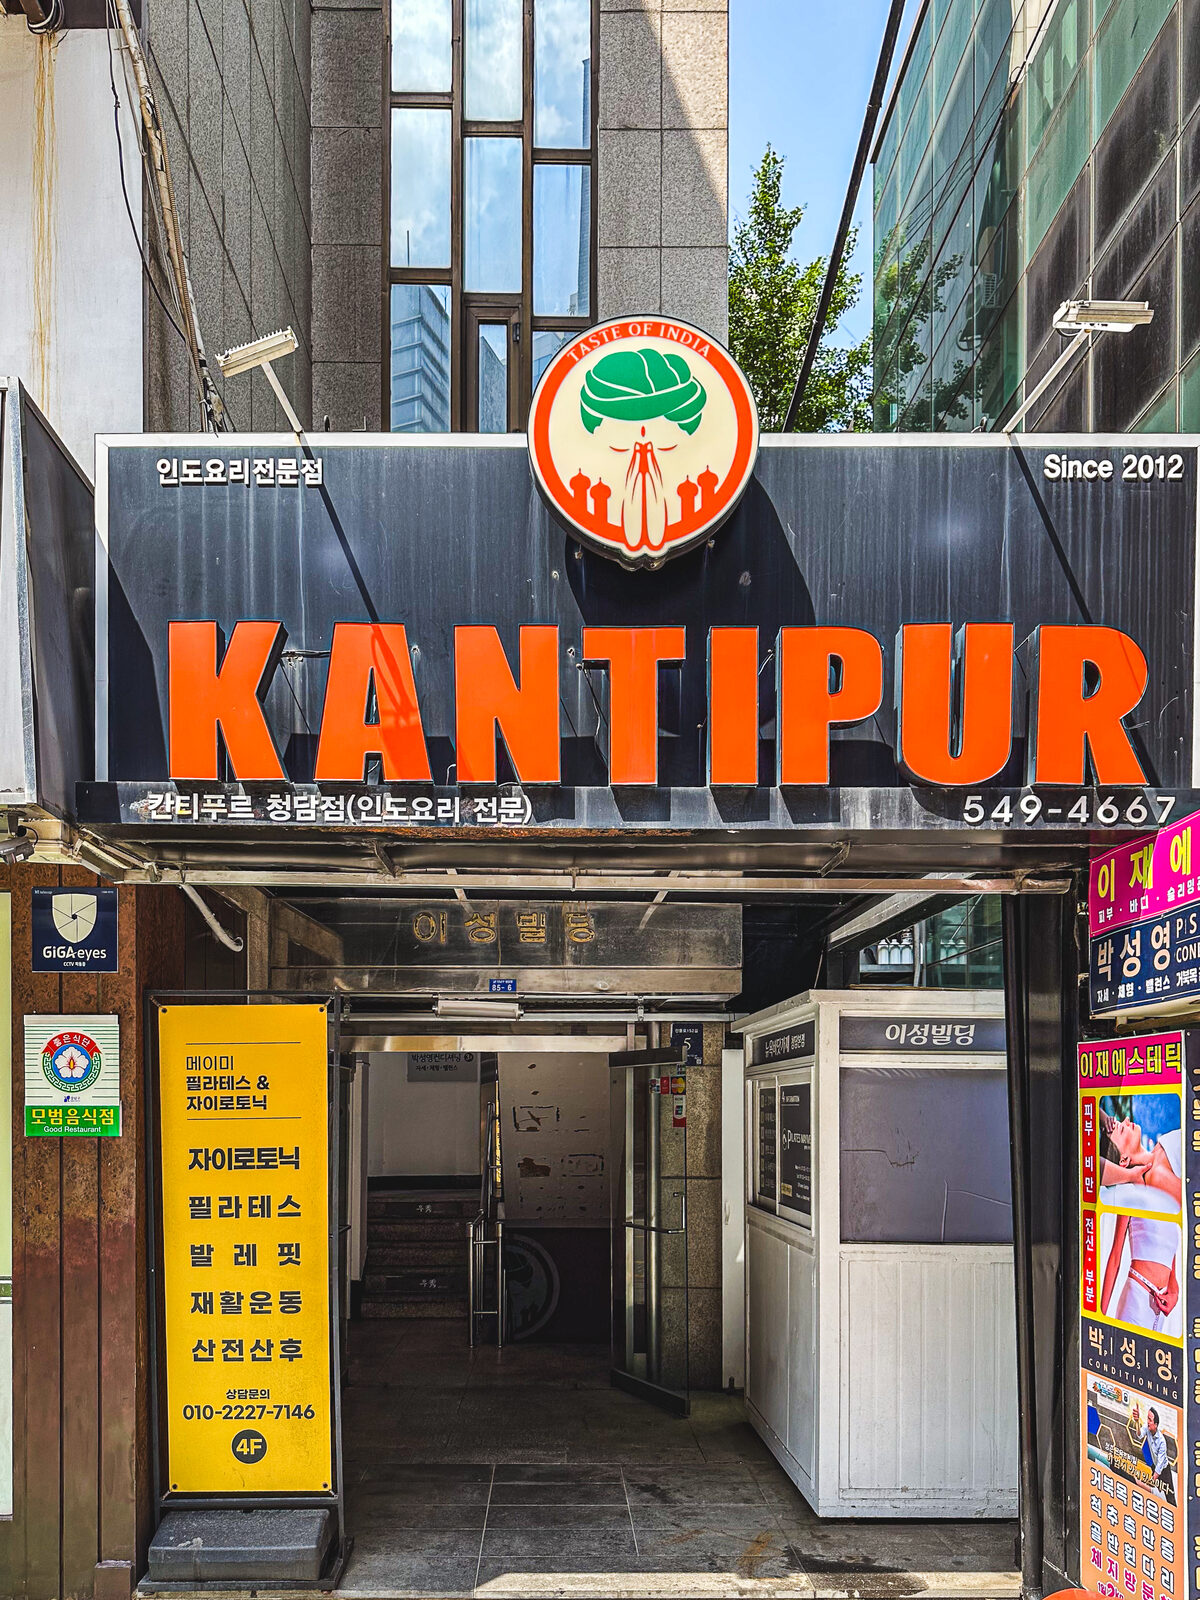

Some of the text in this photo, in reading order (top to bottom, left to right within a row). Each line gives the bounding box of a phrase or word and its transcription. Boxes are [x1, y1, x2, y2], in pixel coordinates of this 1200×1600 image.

[567, 323, 711, 362] TASTE OF INDIA
[156, 457, 324, 487] 인도요리전문점
[1043, 454, 1183, 480] Since 2012
[168, 619, 1149, 788] KANTIPUR
[147, 793, 254, 821] 칸티푸르
[473, 793, 533, 823] 전문)
[963, 794, 1177, 824] 549-4667
[1129, 897, 1149, 914] 바디
[1098, 920, 1171, 982] 박성영
[885, 1023, 976, 1046] 이성빌딩
[186, 1055, 234, 1072] 메이미
[1080, 1043, 1181, 1079] 이재에스테틱
[186, 1075, 270, 1091] 필라테스 &
[186, 1095, 268, 1111] 자이로토닉
[31, 1108, 114, 1126] 모범음식점
[188, 1146, 300, 1171] 자이로토닉
[1084, 1103, 1094, 1193] 피부 비만
[188, 1195, 302, 1219] 필라테스
[1084, 1217, 1095, 1252] 전신
[190, 1291, 303, 1315] 재활운동
[192, 1338, 303, 1362] 산전산후
[1088, 1358, 1178, 1400] CONDITIONING
[226, 1389, 270, 1400] 상담문의
[183, 1404, 315, 1420] 010-2227-7146
[236, 1438, 262, 1455] 4F
[1090, 1467, 1175, 1534] 거북목 굽은등
[1090, 1494, 1175, 1564] 척추측만증
